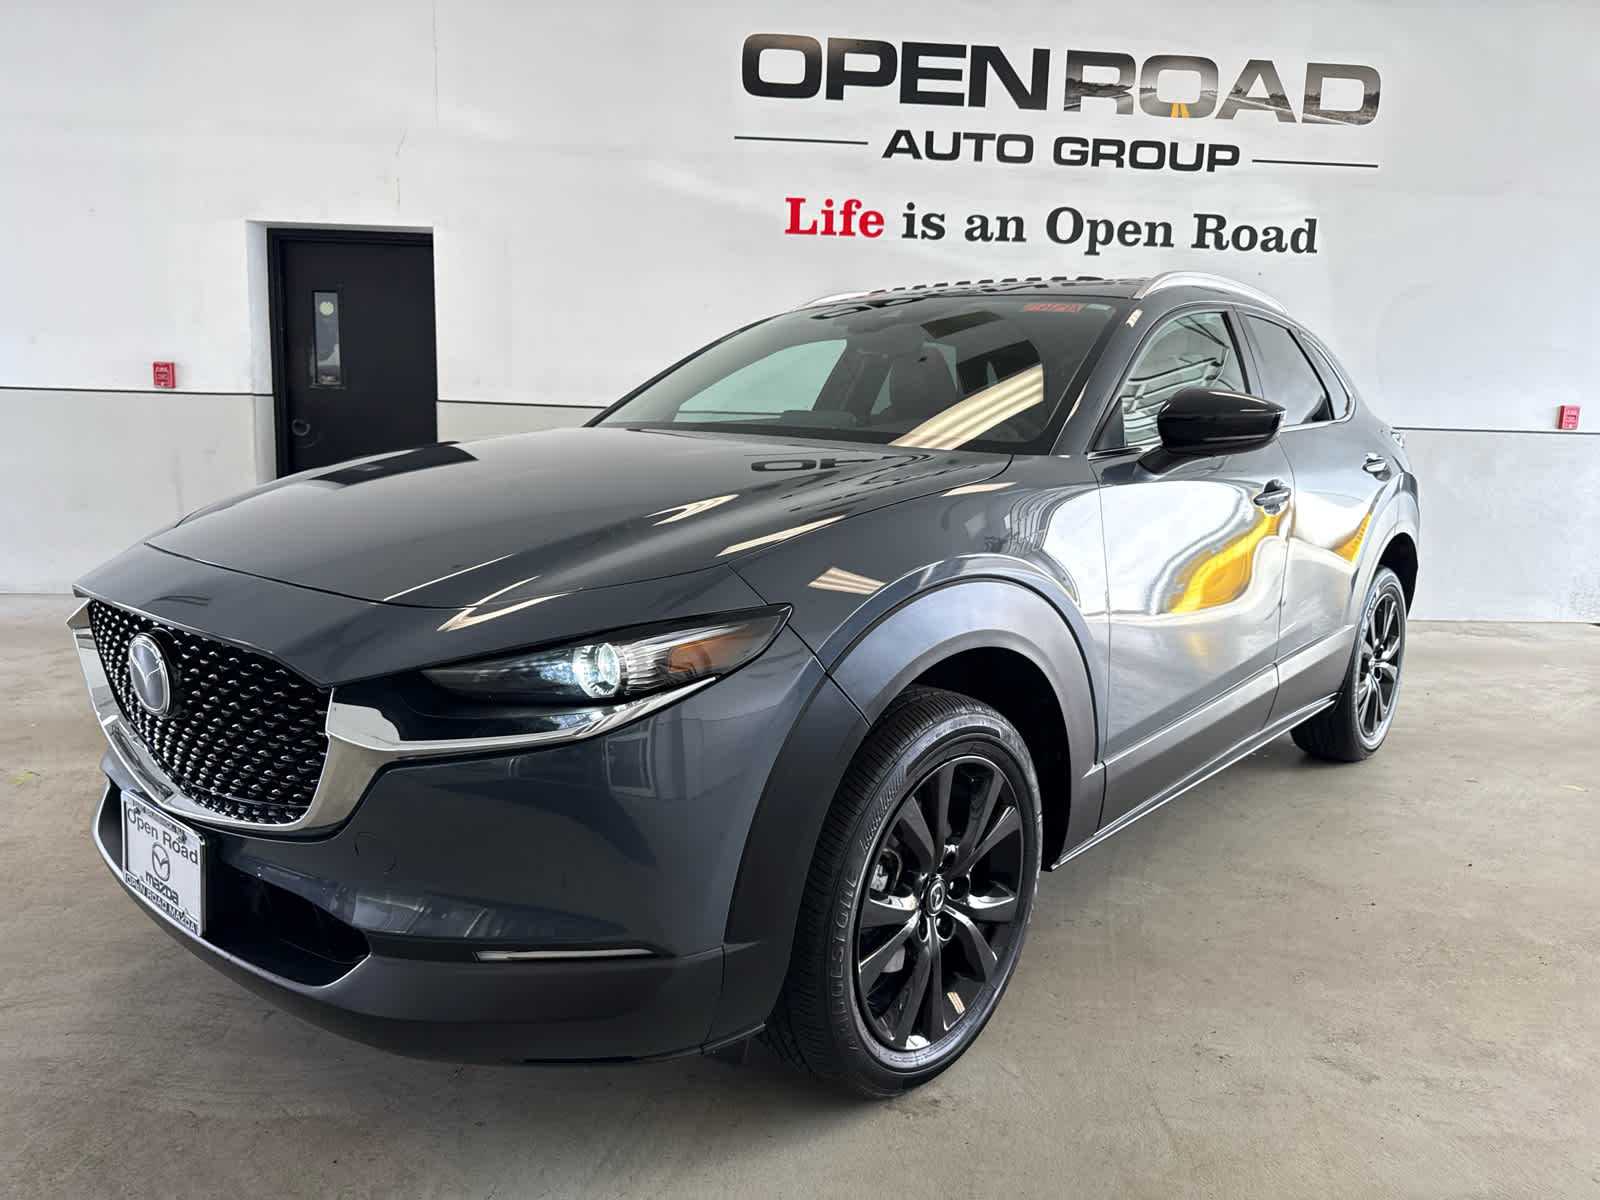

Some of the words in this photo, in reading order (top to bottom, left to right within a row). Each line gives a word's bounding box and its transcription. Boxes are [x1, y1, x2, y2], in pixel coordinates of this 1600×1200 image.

[741, 33, 1050, 111] OPEN
[1063, 49, 1382, 126] ROAD
[881, 129, 1034, 165] AUTO
[1052, 136, 1241, 173] GROUP
[784, 197, 885, 237] Life
[901, 201, 946, 241] is
[964, 214, 1027, 243] an
[1045, 206, 1175, 257] Open
[1190, 213, 1318, 254] Road
[127, 807, 159, 840] Open
[162, 830, 199, 864] Road
